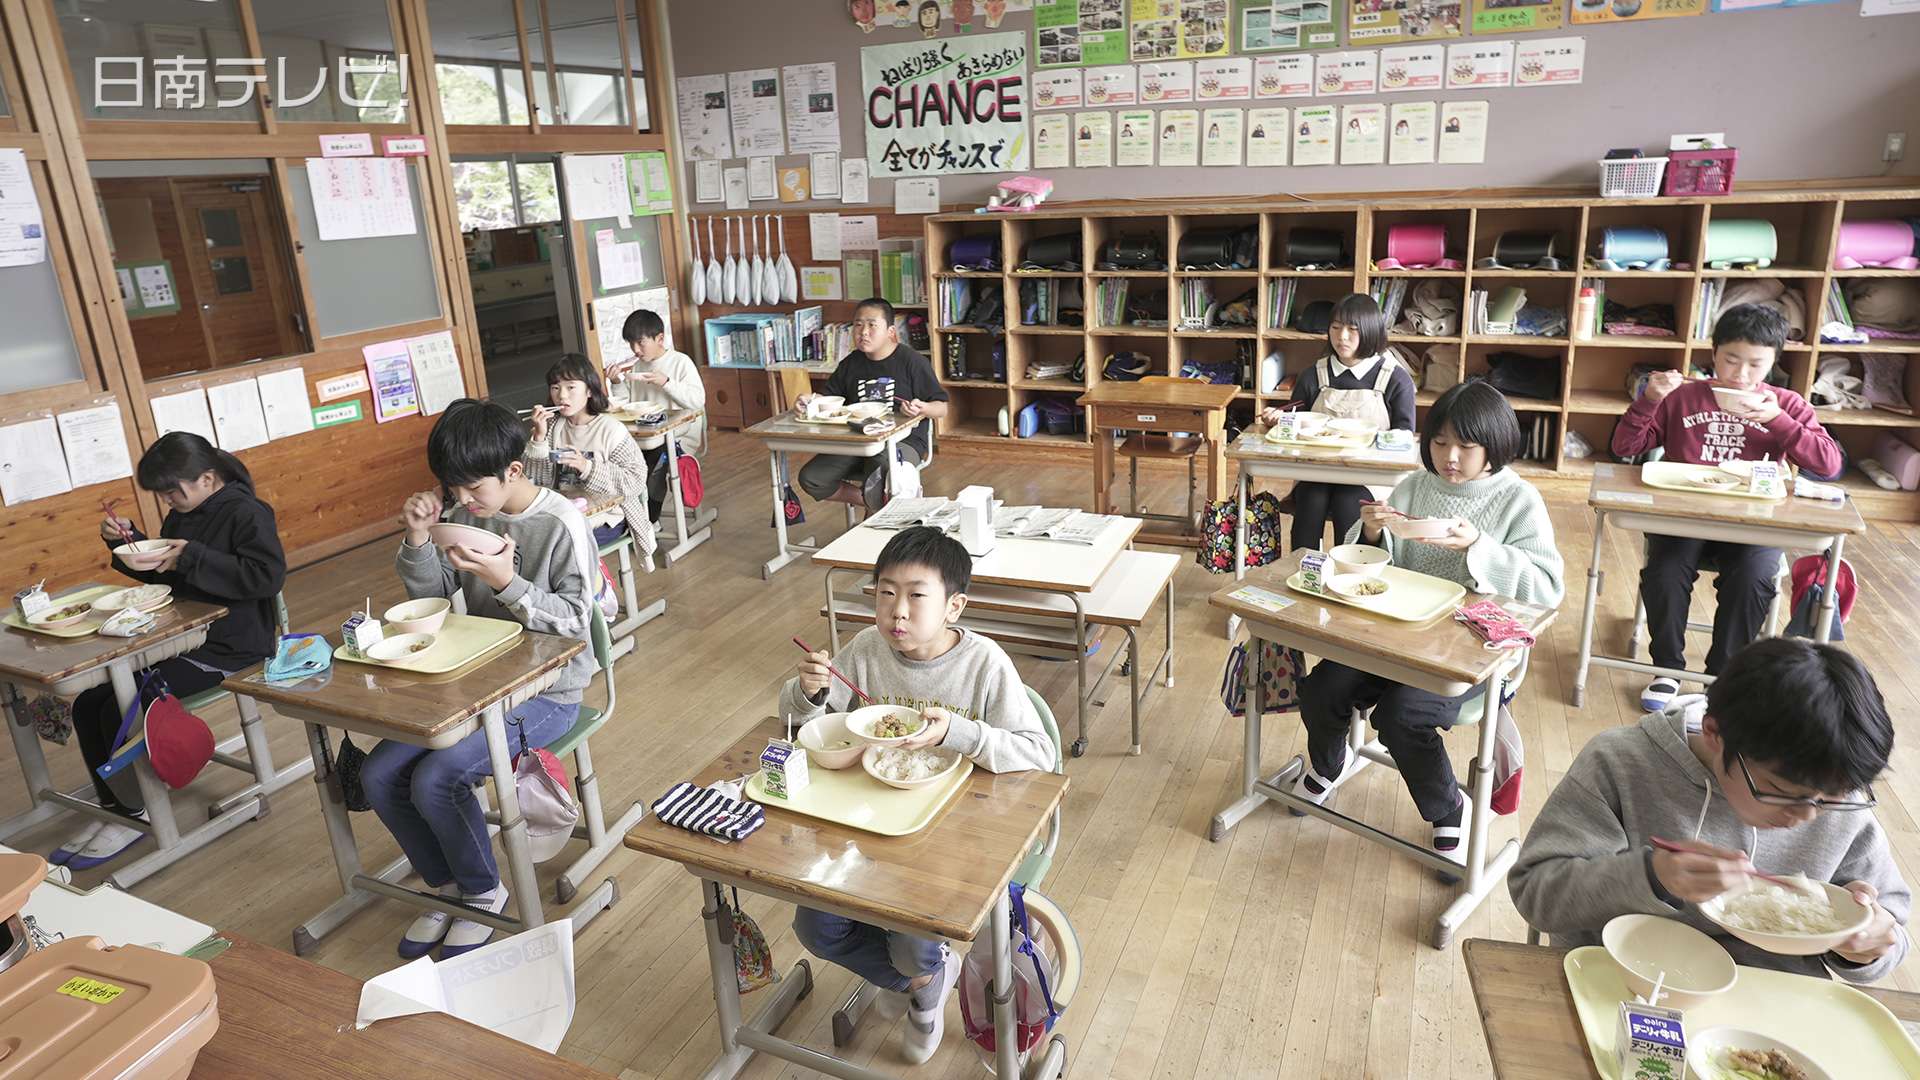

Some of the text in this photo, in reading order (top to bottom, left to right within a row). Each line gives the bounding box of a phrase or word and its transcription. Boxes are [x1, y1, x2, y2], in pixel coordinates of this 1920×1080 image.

[881, 42, 1025, 86] ねばり強く あきらめない
[868, 76, 1023, 129] CHANCE
[1703, 433, 1747, 448] TRACK
[1631, 1040, 1684, 1058] デーリィ牛乳
